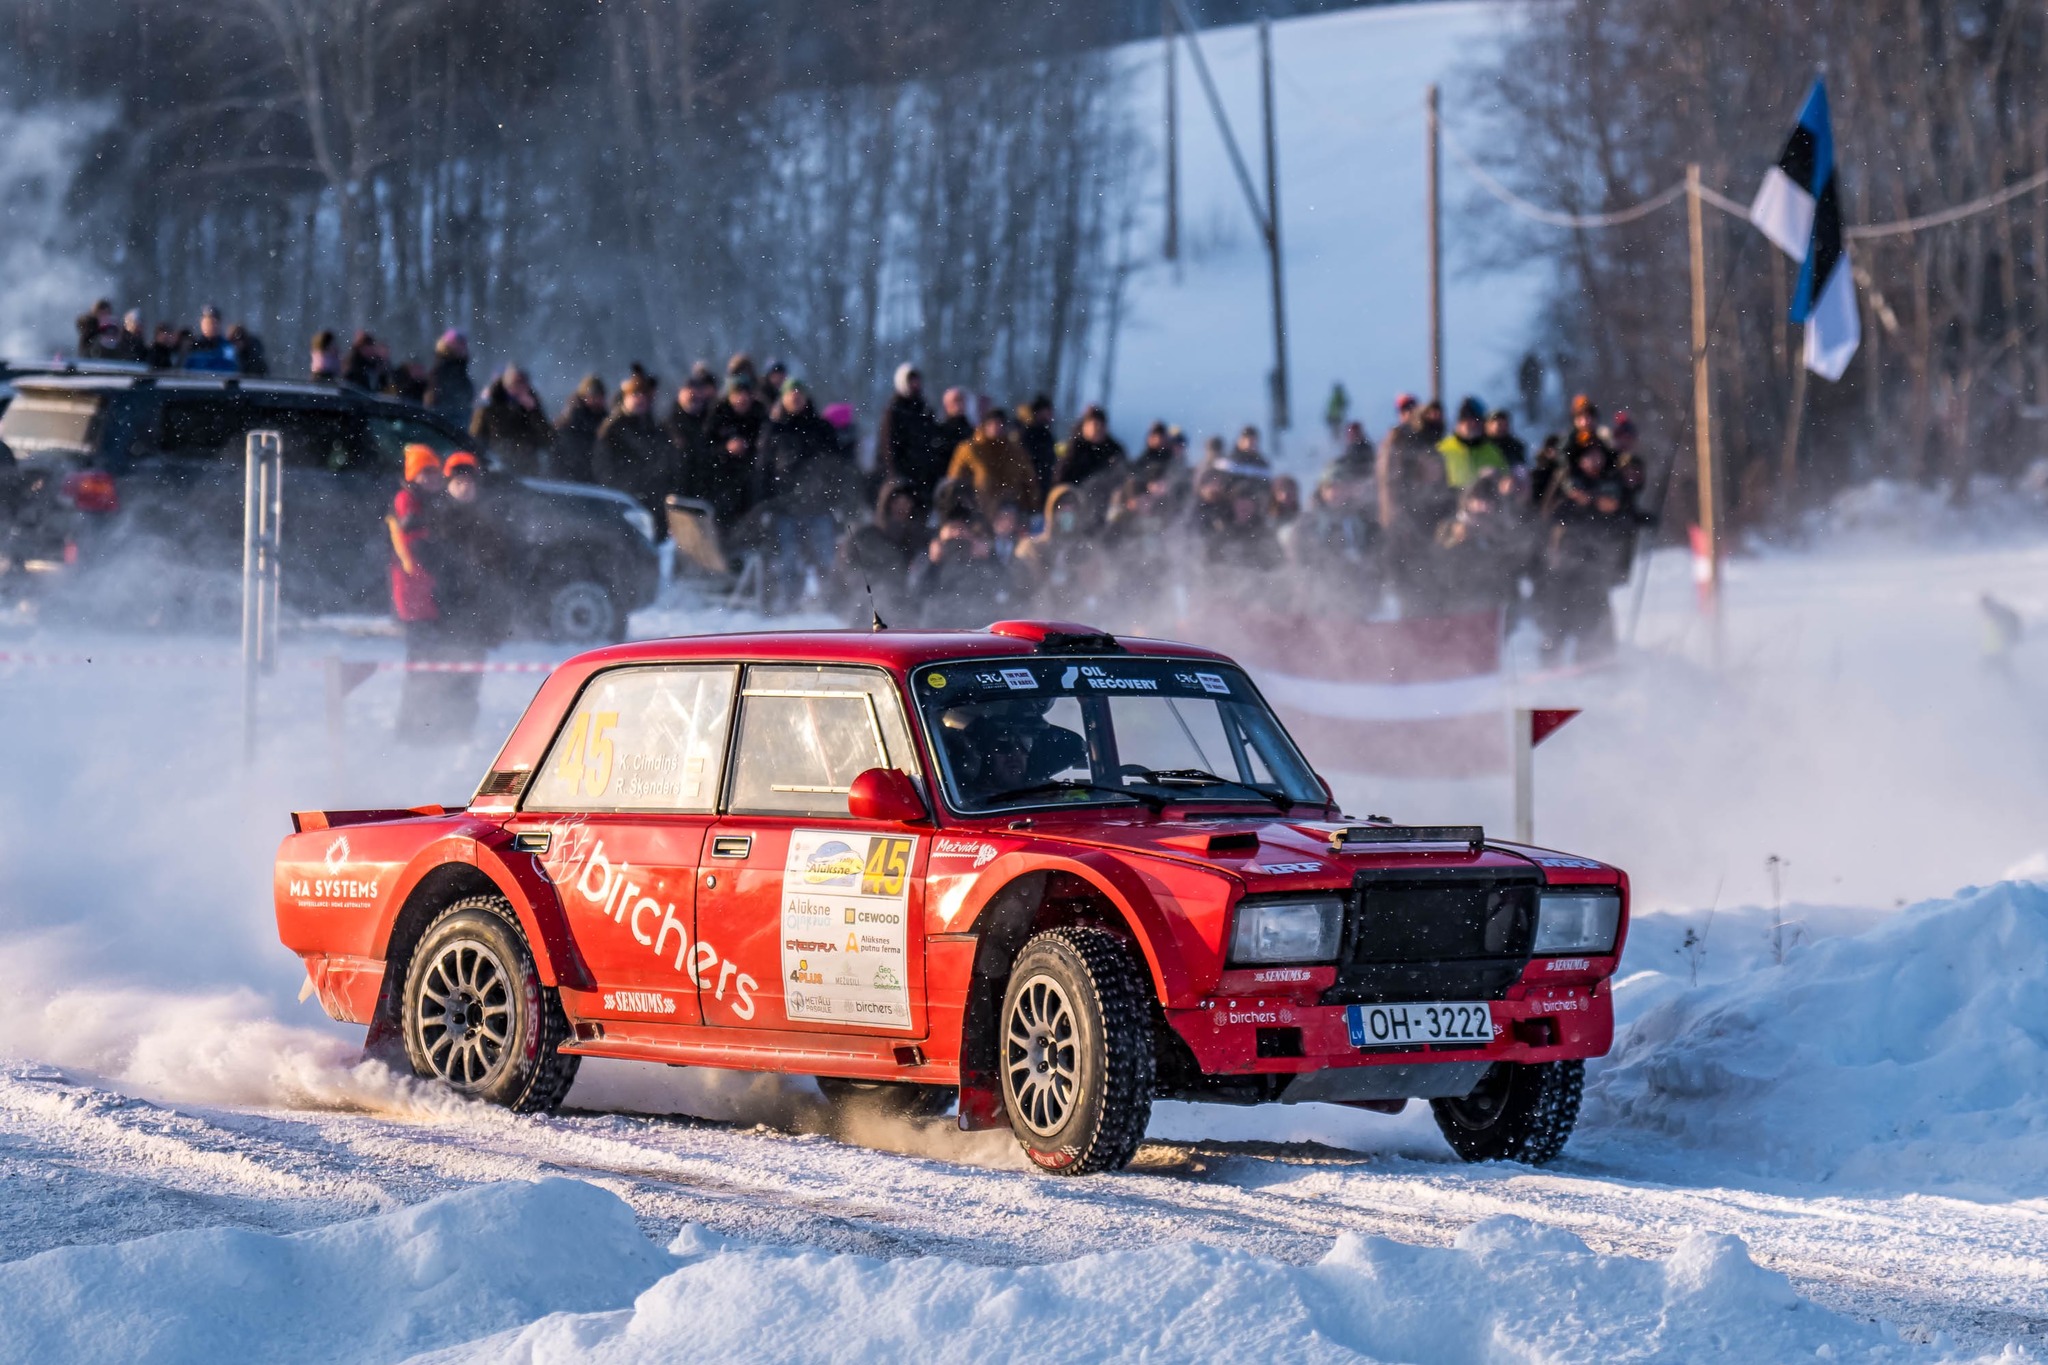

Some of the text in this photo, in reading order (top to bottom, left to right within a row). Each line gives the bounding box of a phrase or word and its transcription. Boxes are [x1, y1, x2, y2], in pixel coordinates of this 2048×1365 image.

[1080, 666, 1107, 676] OIL
[1088, 678, 1158, 690] RECOVERY
[558, 711, 619, 797] 45
[618, 754, 631, 770] K.
[616, 777, 628, 794] R.
[935, 838, 979, 853] Mežvide
[807, 862, 851, 875] Alūksne
[862, 838, 910, 895] 45
[290, 879, 378, 898] MA SYSTEMS
[788, 899, 831, 916] Alūksne
[858, 912, 900, 925] CEWOOD
[576, 839, 760, 1021] birchers
[860, 935, 890, 945] Alūksnes
[881, 945, 901, 954] ferma
[1263, 969, 1303, 982] SENSUMS
[615, 991, 664, 1014] SENSUMS
[856, 1000, 893, 1015] birchers
[1543, 1001, 1578, 1012] birchers
[1229, 1010, 1277, 1024] birchers
[1351, 1030, 1363, 1040] LV
